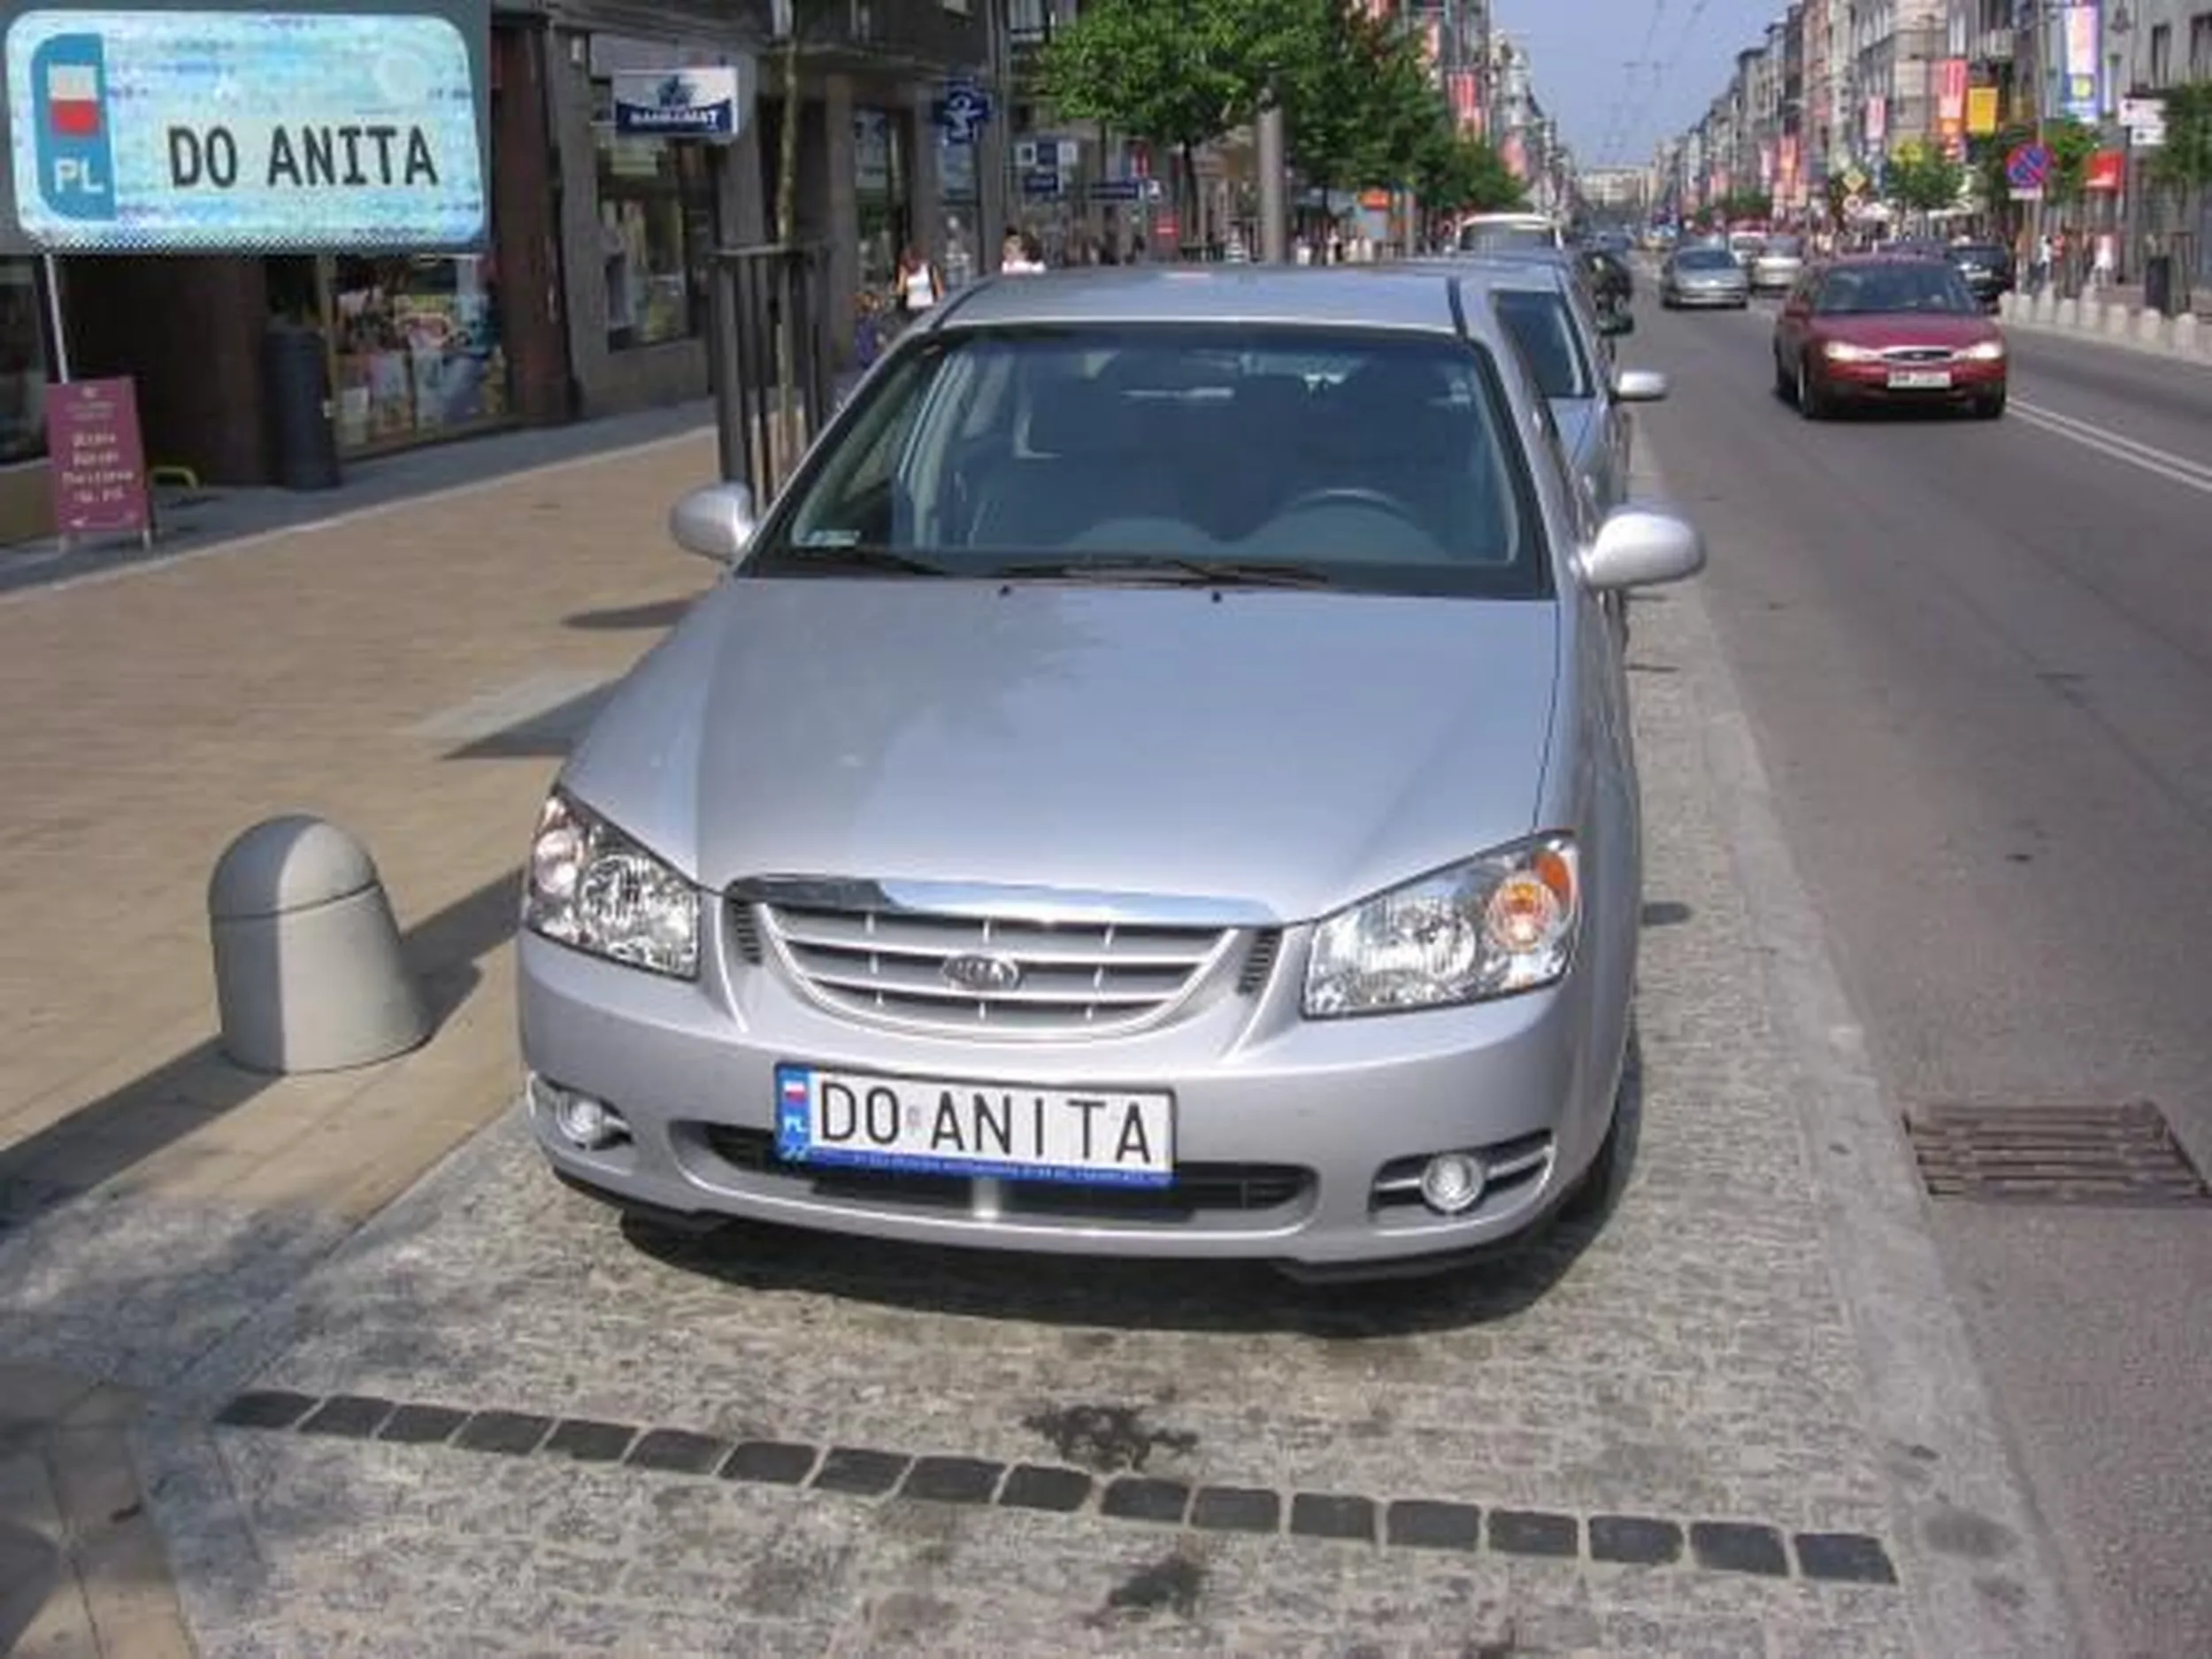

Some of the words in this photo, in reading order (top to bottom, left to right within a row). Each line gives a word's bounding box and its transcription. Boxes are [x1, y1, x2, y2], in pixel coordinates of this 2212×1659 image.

[783, 1115, 809, 1133] PL
[820, 1080, 901, 1146] DO
[931, 1089, 1151, 1164] ANITA
